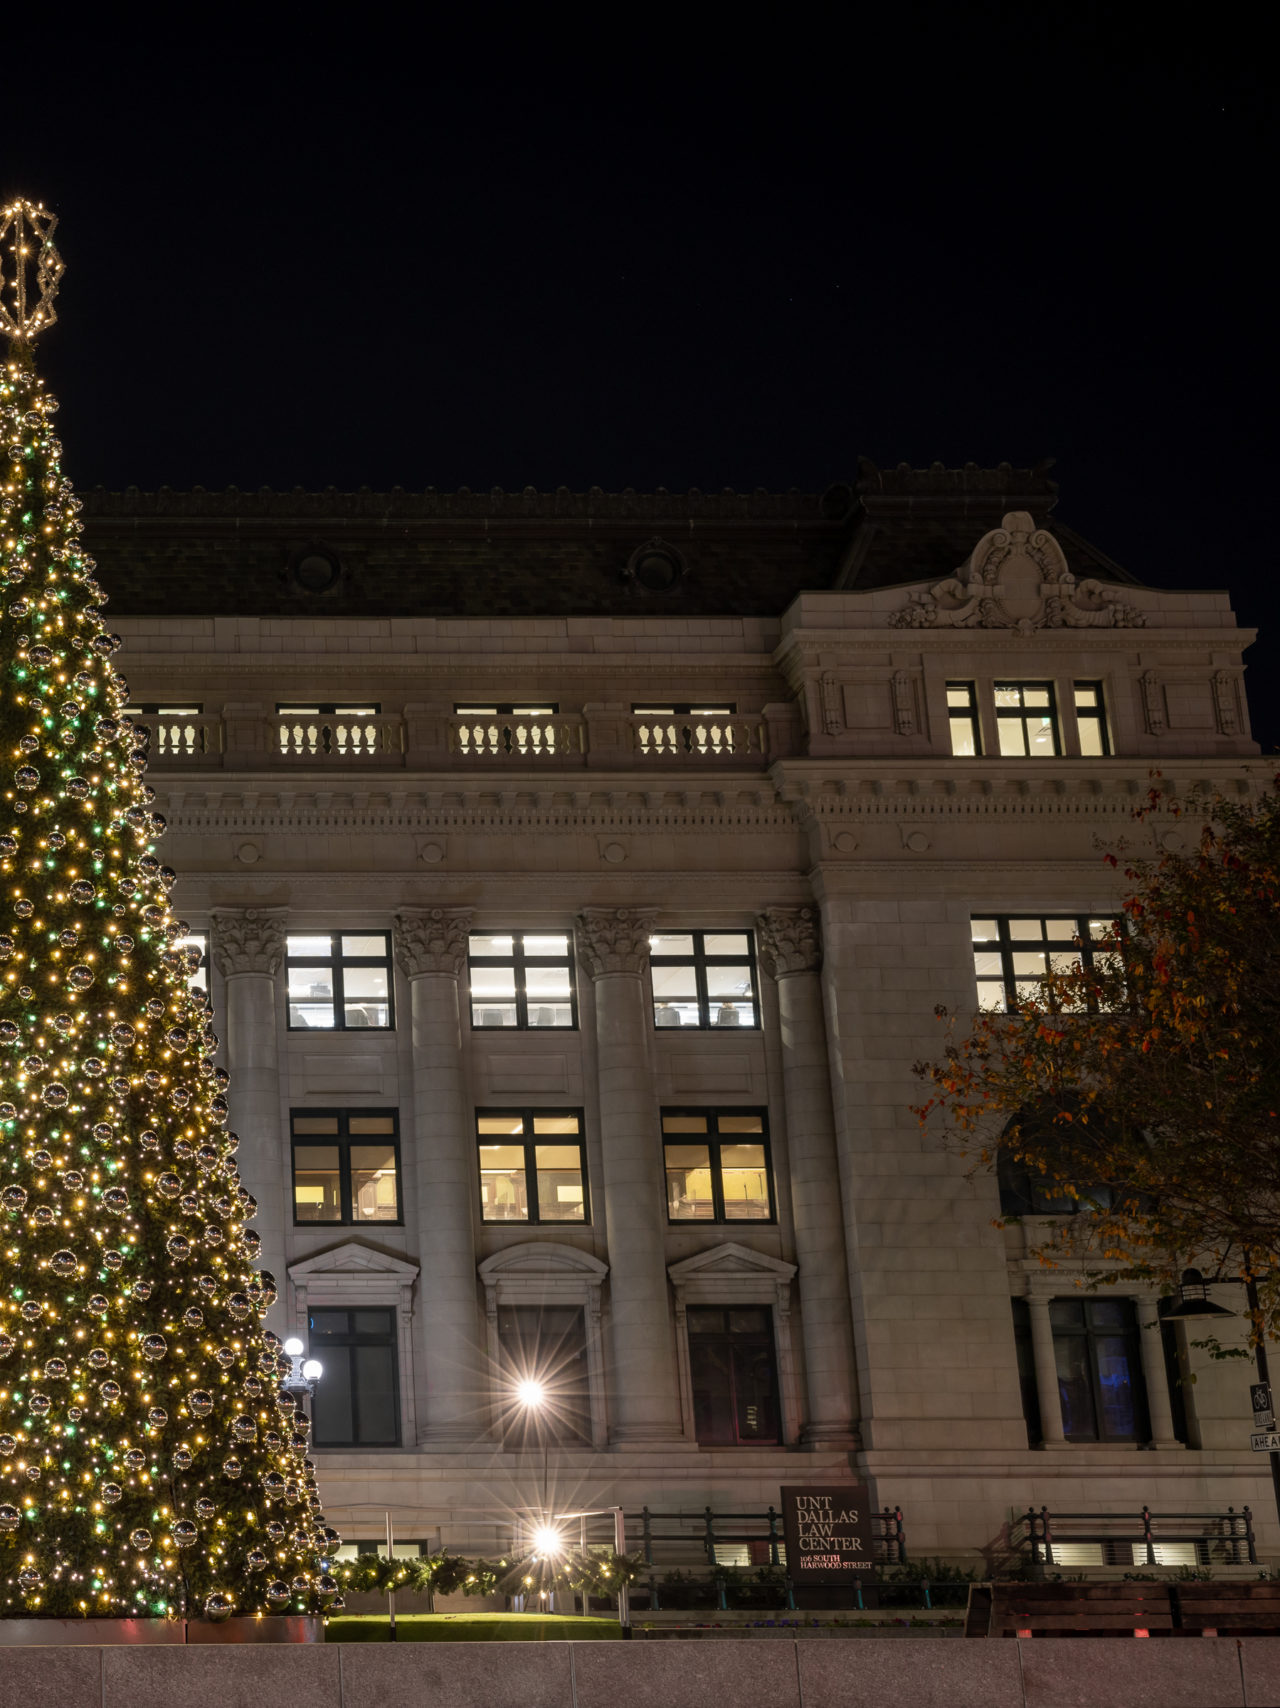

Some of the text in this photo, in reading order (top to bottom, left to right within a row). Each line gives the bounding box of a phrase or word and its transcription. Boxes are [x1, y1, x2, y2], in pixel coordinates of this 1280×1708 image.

[1254, 1435, 1280, 1449] AHEA
[795, 1496, 832, 1510] UNT
[797, 1509, 859, 1523] DALLAS
[798, 1523, 834, 1537] LAW
[799, 1537, 864, 1551] CENTER
[800, 1561, 872, 1569] HARWOOD STREET
[813, 1554, 840, 1562] SOUTH
